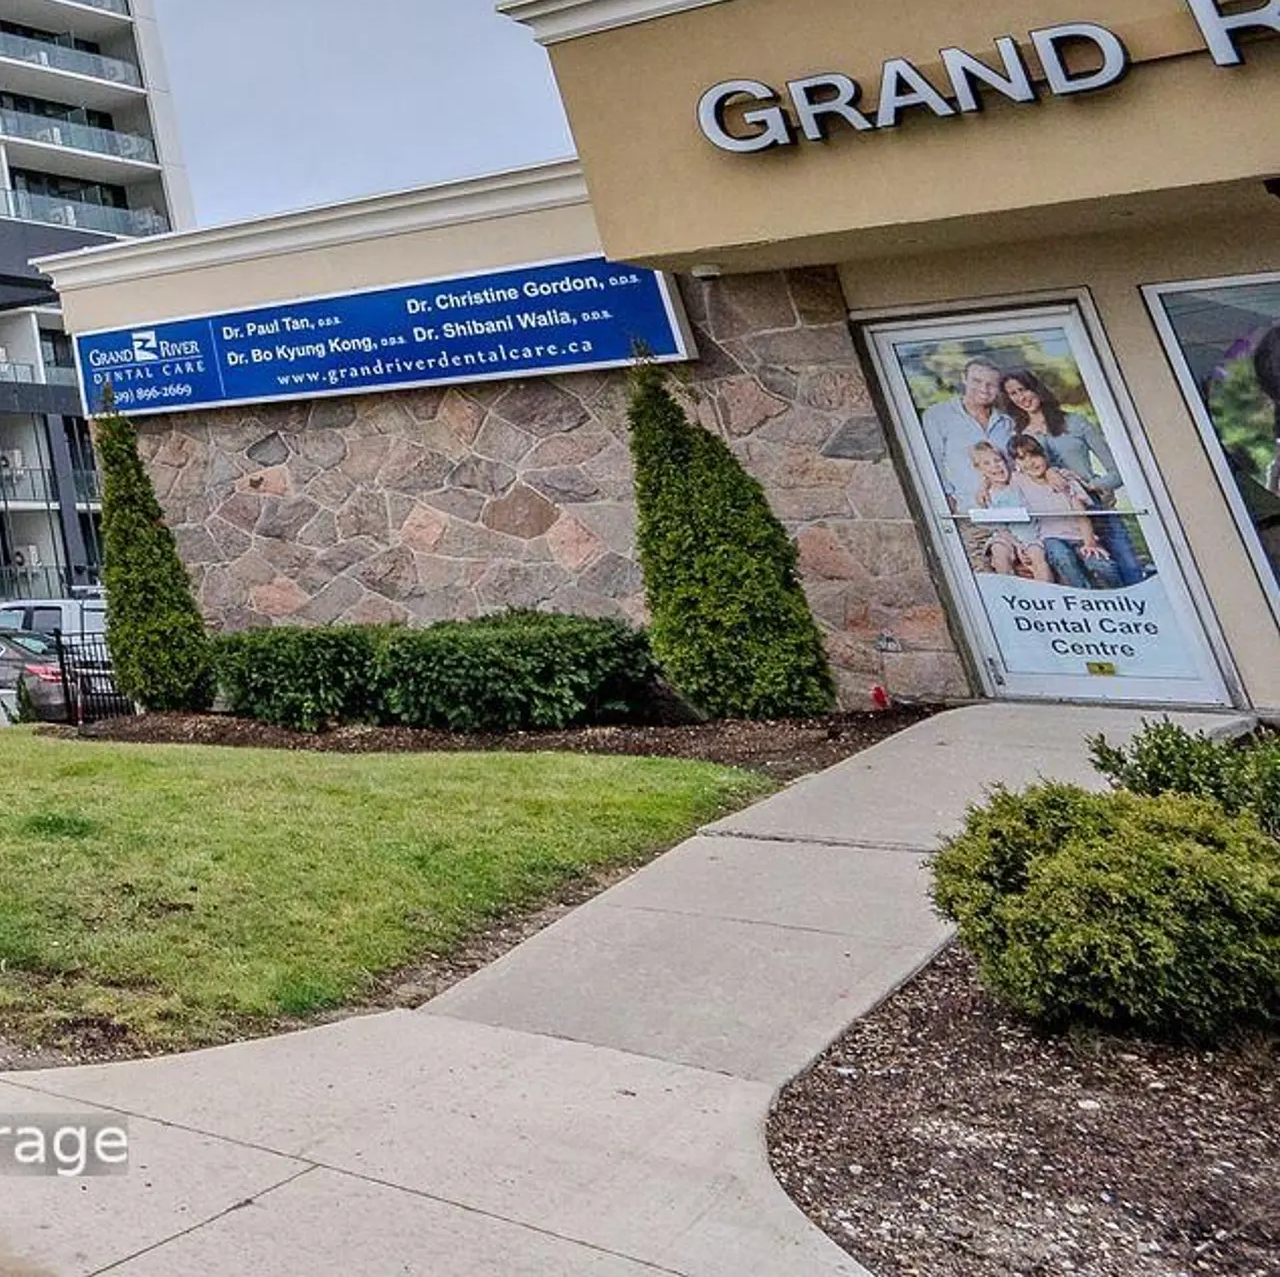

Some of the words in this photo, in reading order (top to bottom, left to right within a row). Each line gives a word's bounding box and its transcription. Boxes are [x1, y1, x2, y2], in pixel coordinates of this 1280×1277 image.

[696, 21, 1130, 154] GRAND
[407, 298, 432, 314] Dr.
[435, 286, 519, 310] Christine
[523, 274, 605, 298] Gordon,
[222, 326, 244, 340] Dr.
[247, 320, 279, 337] Paul
[282, 317, 315, 331] Tan,
[413, 326, 439, 343] Dr.
[443, 317, 513, 339] Shibani
[517, 309, 578, 329] Walia,
[89, 348, 133, 367] GRAND
[159, 340, 200, 358] RIVER
[227, 351, 249, 366] Dr.
[251, 348, 273, 363] Bo
[276, 342, 326, 362] Kyung
[328, 337, 378, 353] Kong,
[277, 339, 593, 385] www.grandriverdentalcare.ca
[161, 360, 206, 377] CARE
[1002, 595, 1056, 611] Your
[1062, 595, 1146, 616] Family
[1014, 616, 1092, 634] Dental
[1098, 618, 1159, 635] Care
[1051, 639, 1136, 657] Centre
